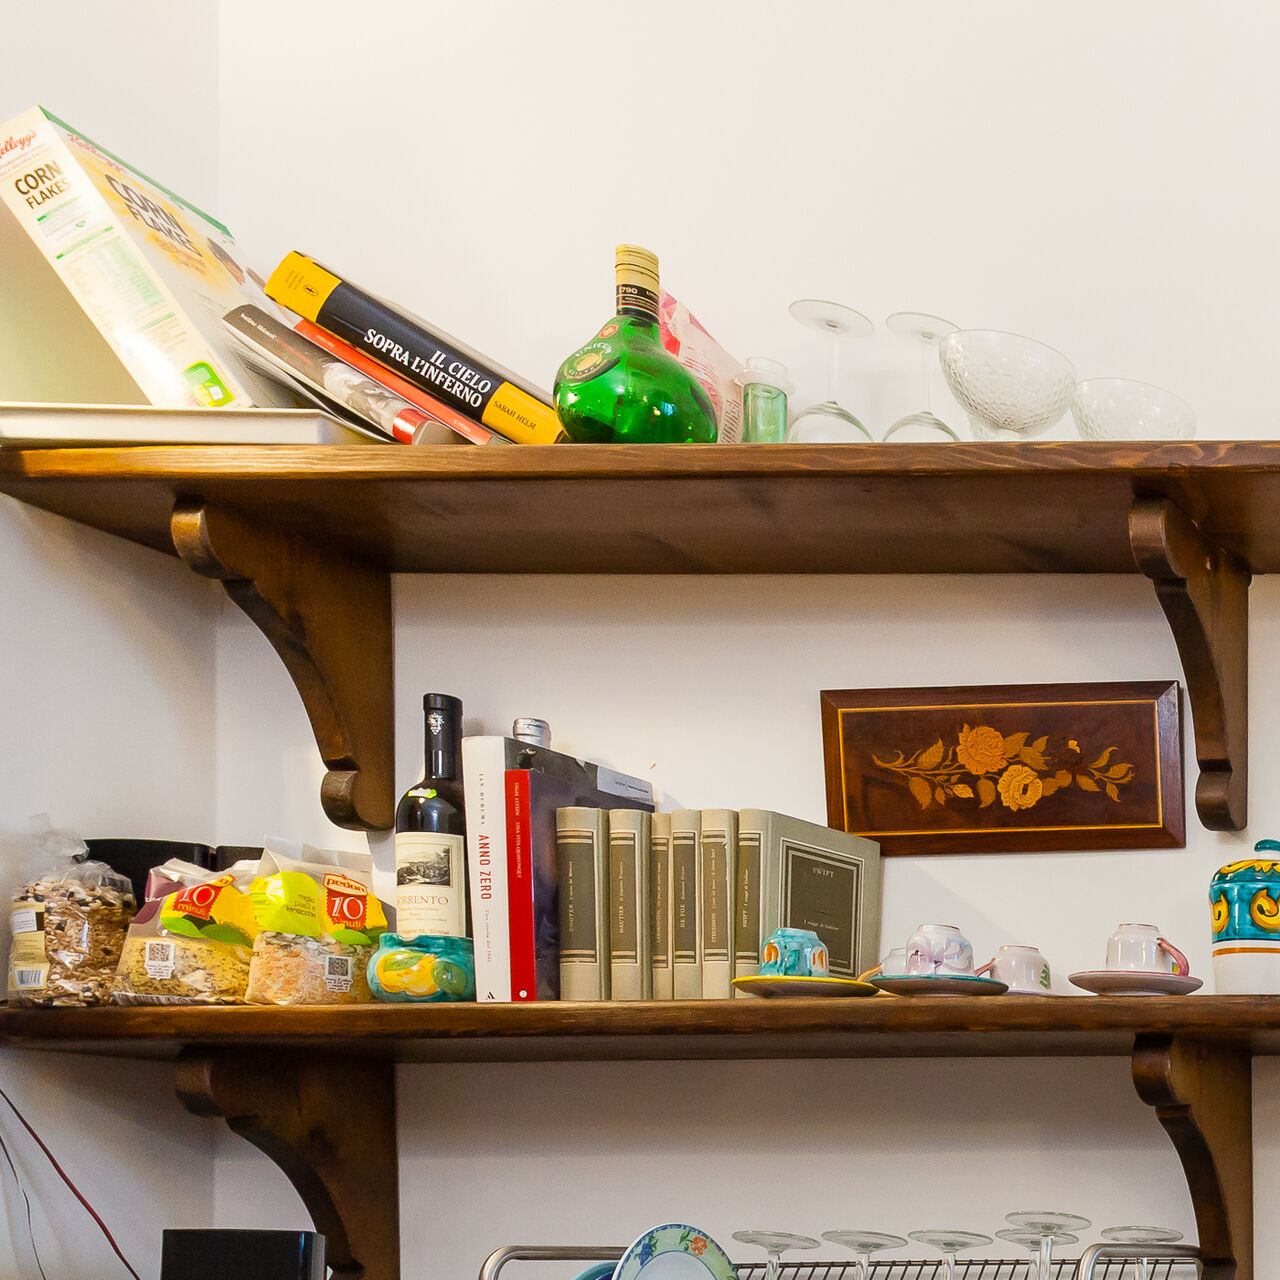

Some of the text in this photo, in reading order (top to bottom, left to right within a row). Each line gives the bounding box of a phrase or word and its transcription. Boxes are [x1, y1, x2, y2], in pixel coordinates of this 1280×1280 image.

[14, 160, 63, 196] CORN
[25, 178, 71, 210] FLAKES
[105, 174, 188, 237] CORN
[125, 202, 203, 258] FLAKES
[363, 328, 410, 366] SOPRA
[410, 356, 483, 408] L'INFERNO
[429, 349, 492, 395] IL CIELO
[493, 400, 537, 431] SARAH HELM
[479, 834, 492, 901] ANNO ZERO
[179, 886, 215, 906] 10
[331, 896, 364, 920] 10
[397, 895, 449, 905] ORRENTO
